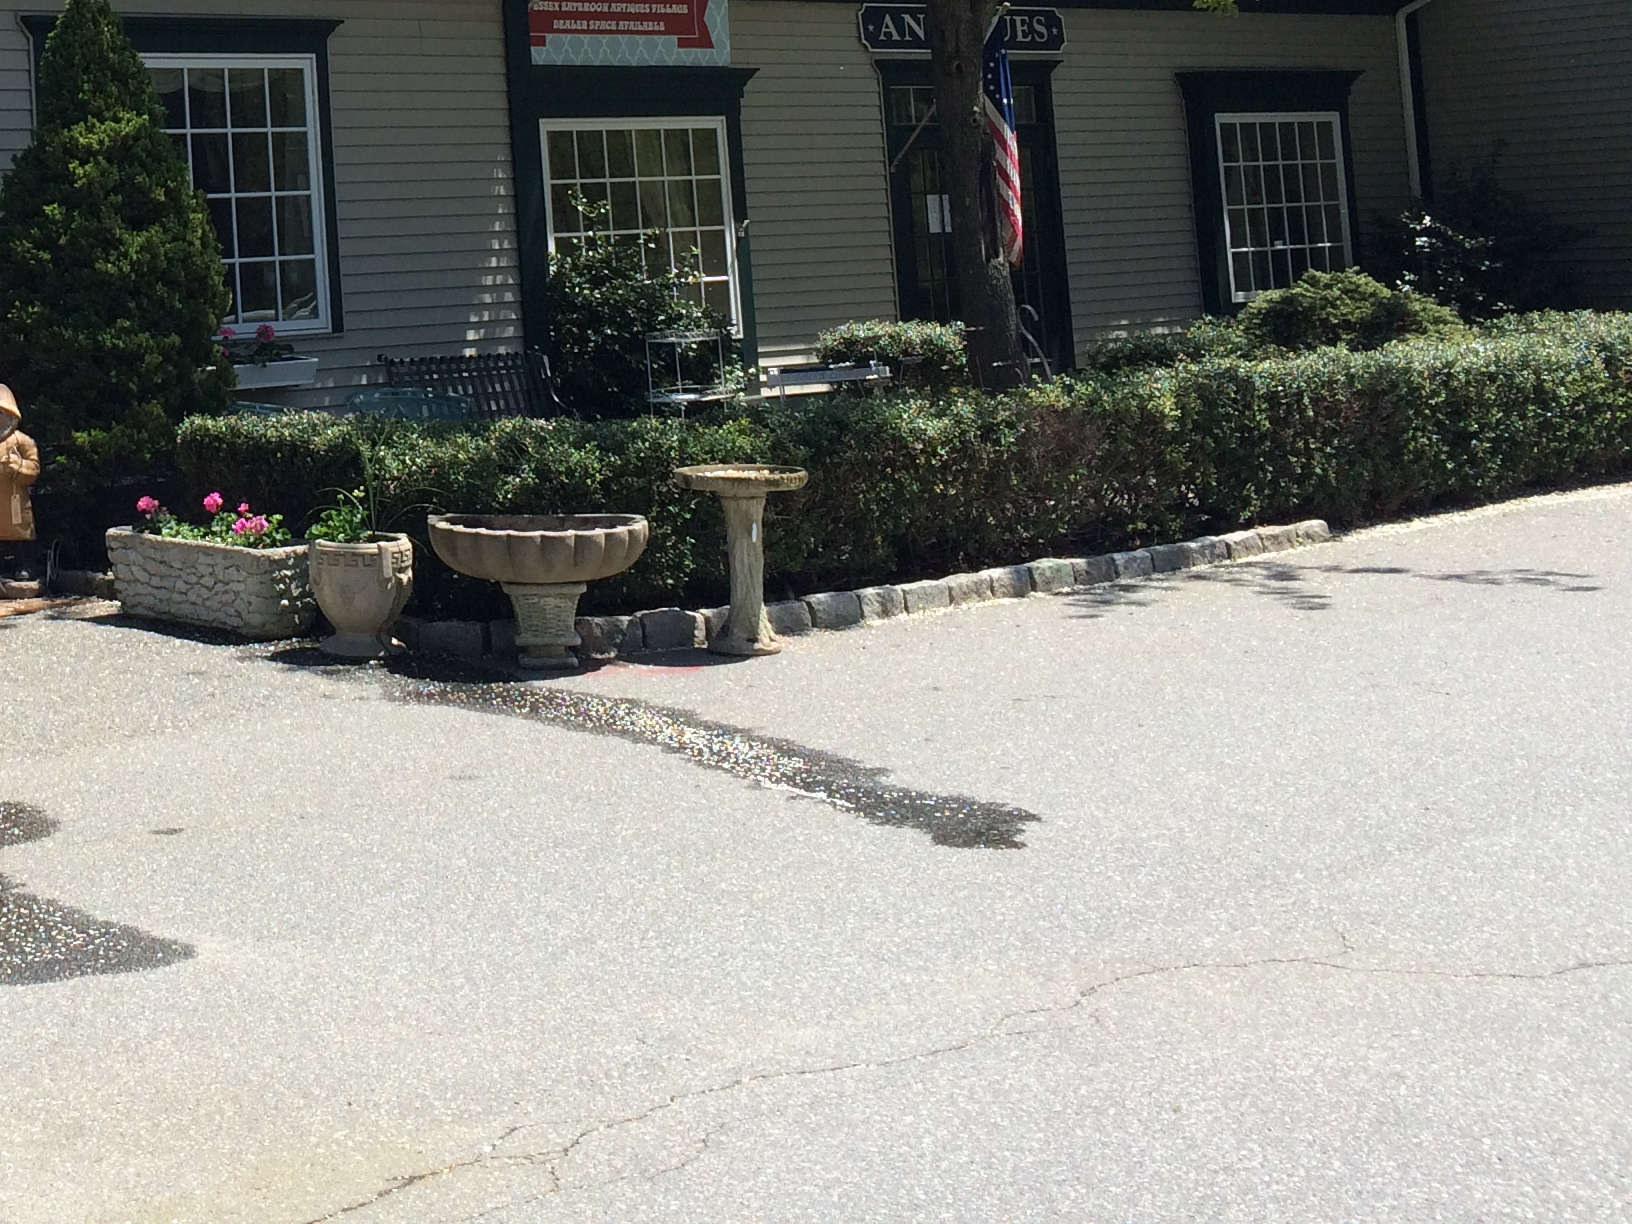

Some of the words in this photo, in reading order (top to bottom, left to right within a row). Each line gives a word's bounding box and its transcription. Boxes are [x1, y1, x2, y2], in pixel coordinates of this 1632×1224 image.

[651, 3, 689, 14] VILLAGE
[553, 19, 588, 30] DEALER
[589, 20, 617, 31] SPACE
[618, 20, 665, 31] AVAILABLE
[878, 13, 1048, 42] ANES
